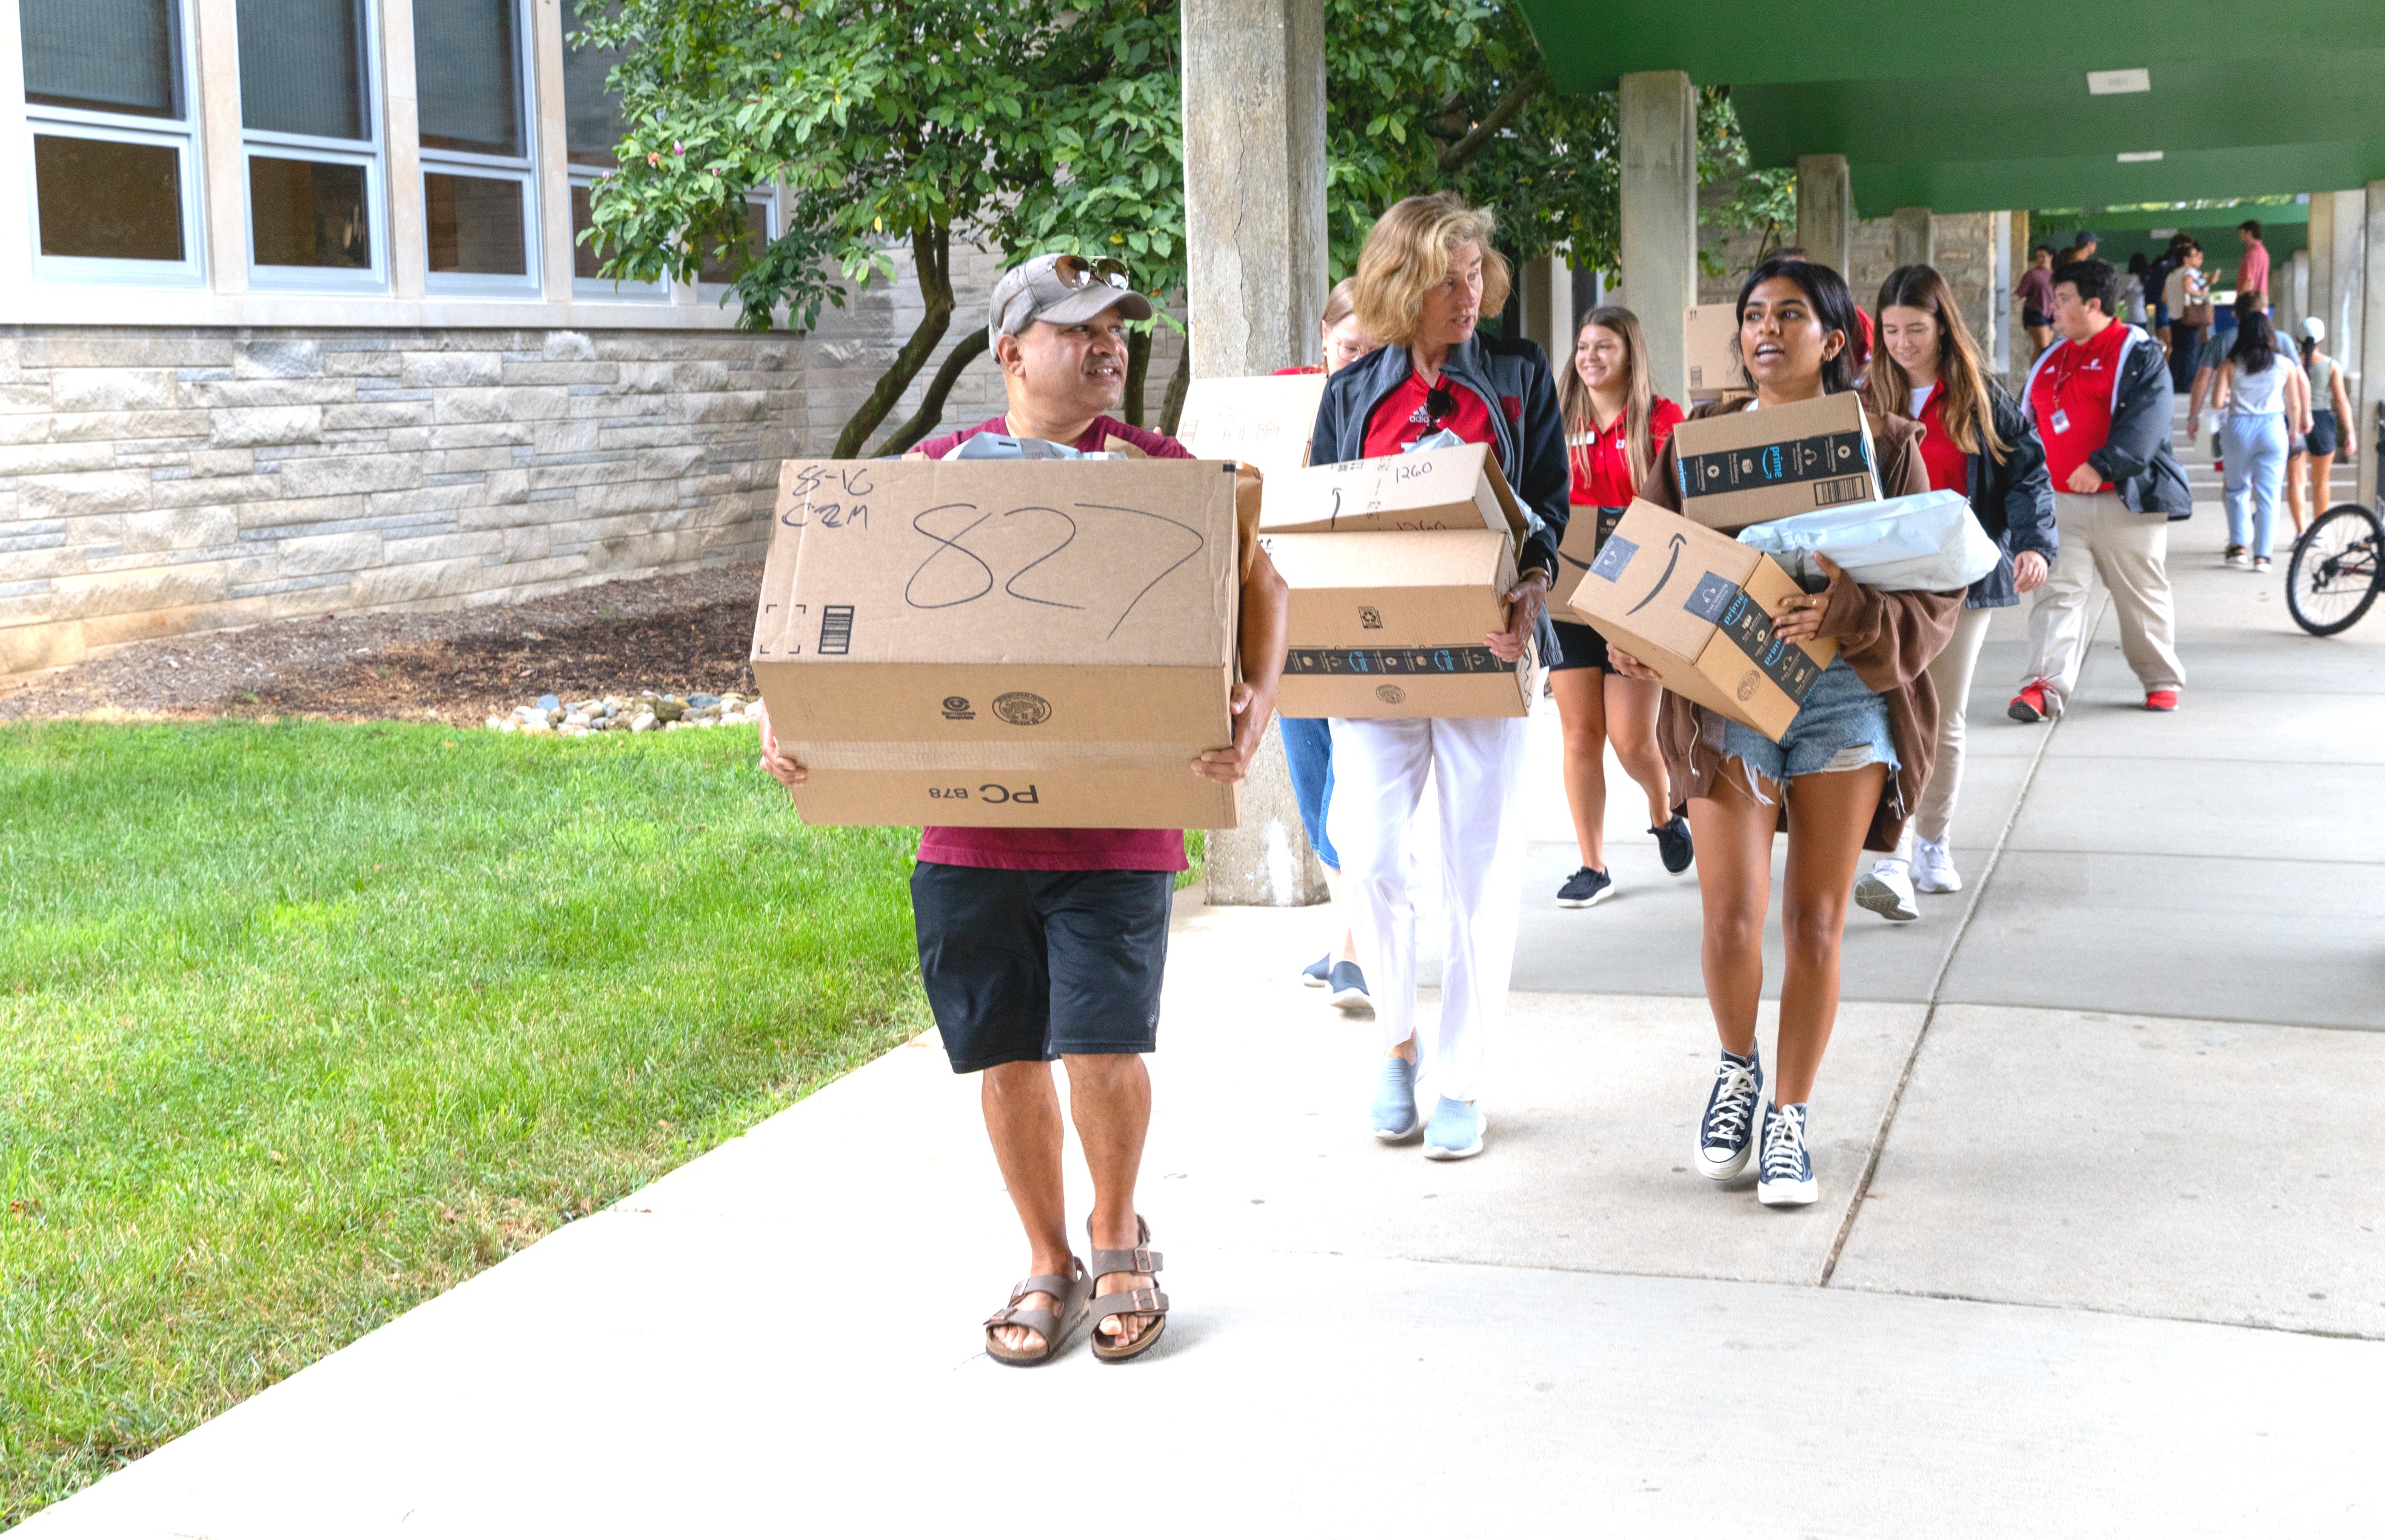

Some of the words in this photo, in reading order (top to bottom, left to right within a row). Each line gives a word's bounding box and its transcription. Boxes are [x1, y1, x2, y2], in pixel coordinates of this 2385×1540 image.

[1409, 411, 1440, 423] adid
[1396, 461, 1433, 484] 1260
[1769, 445, 1784, 478] prime
[905, 502, 1205, 641] 827
[1724, 593, 1745, 626] prime
[928, 787, 968, 799] B78
[978, 783, 1039, 804] PC
